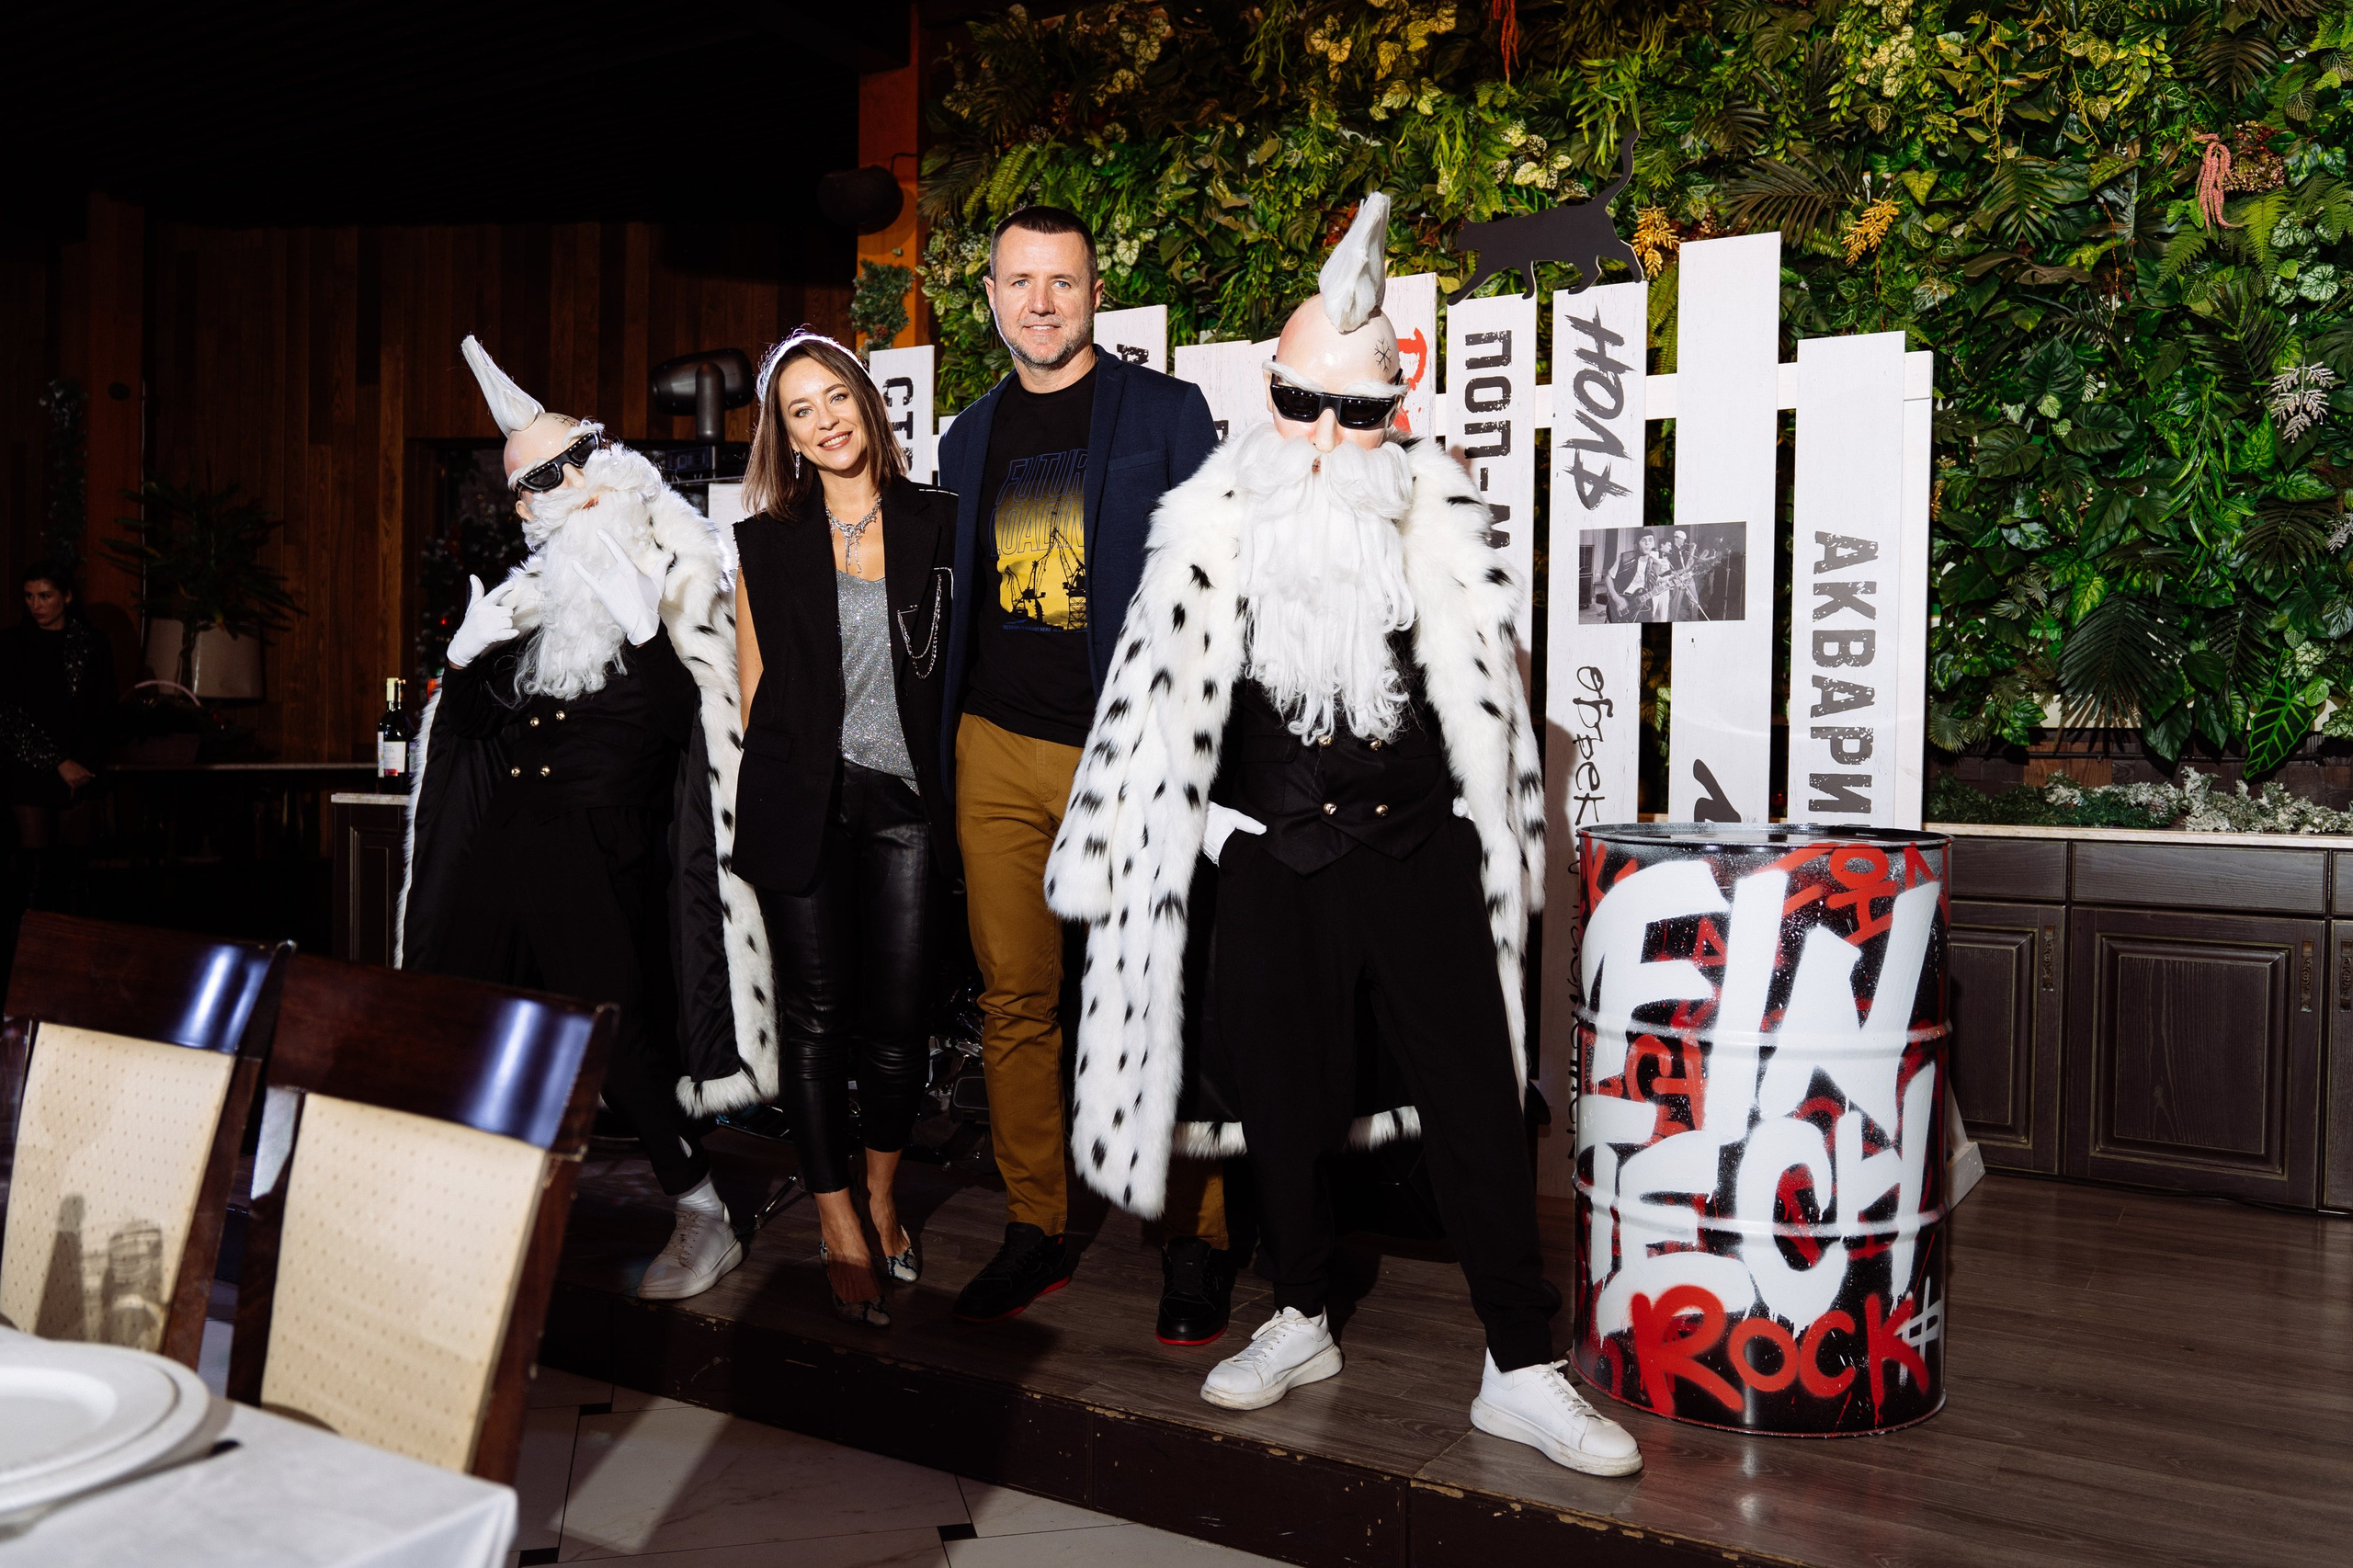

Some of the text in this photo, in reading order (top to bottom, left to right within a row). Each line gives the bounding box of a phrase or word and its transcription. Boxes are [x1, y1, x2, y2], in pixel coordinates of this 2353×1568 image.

[882, 377, 914, 472] СТ
[1808, 530, 1879, 826] АКВАРИ
[1571, 665, 1615, 873] объек
[1630, 1284, 1929, 1418] ROCK
